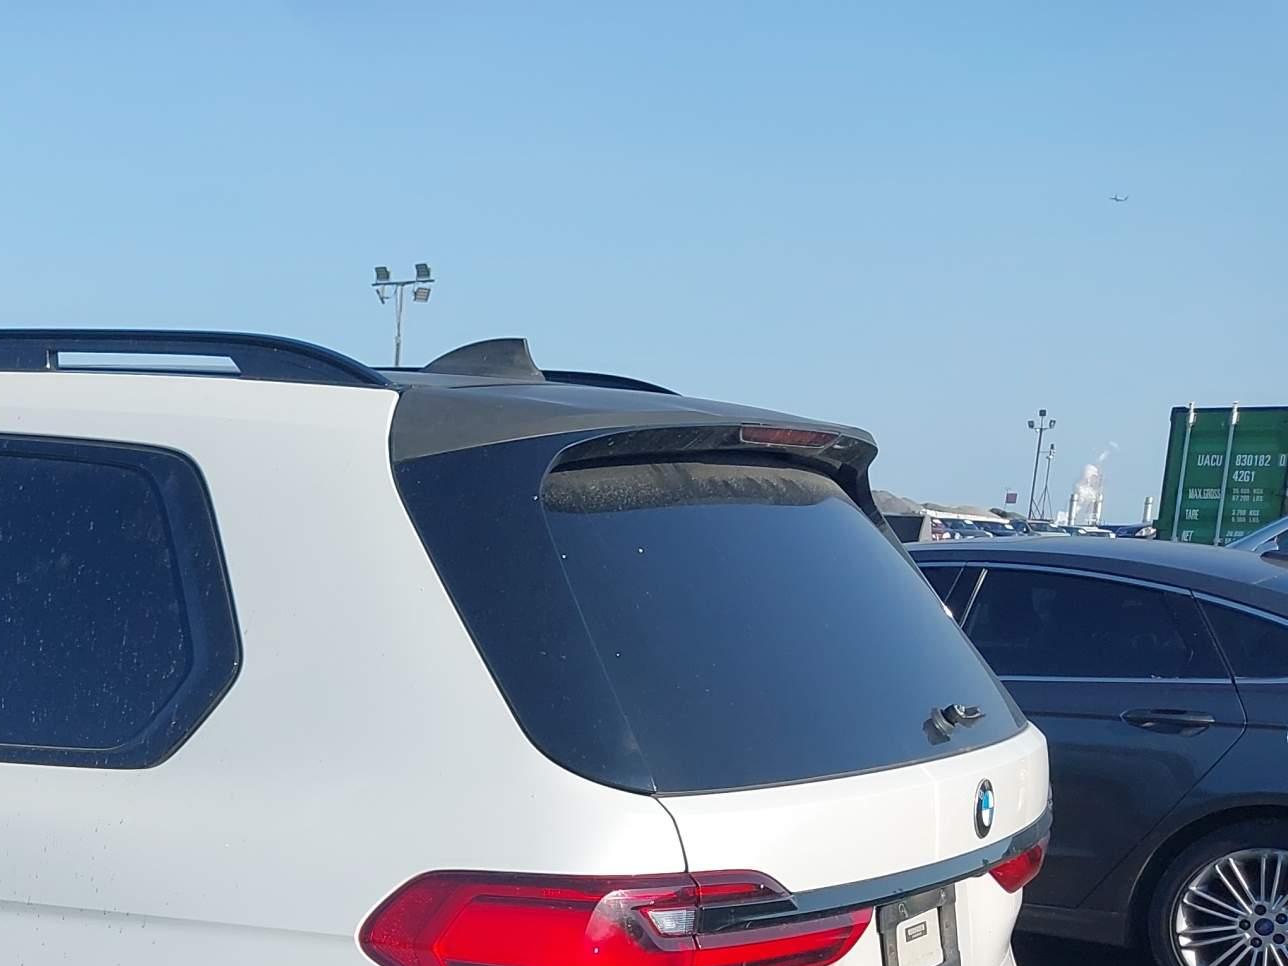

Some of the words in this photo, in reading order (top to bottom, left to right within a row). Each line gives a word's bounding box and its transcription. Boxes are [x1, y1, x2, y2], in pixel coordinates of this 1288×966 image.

[1197, 454, 1223, 466] UACU
[1235, 454, 1271, 467] 830182
[1232, 470, 1255, 482] 42G1
[1185, 509, 1200, 520] TARE
